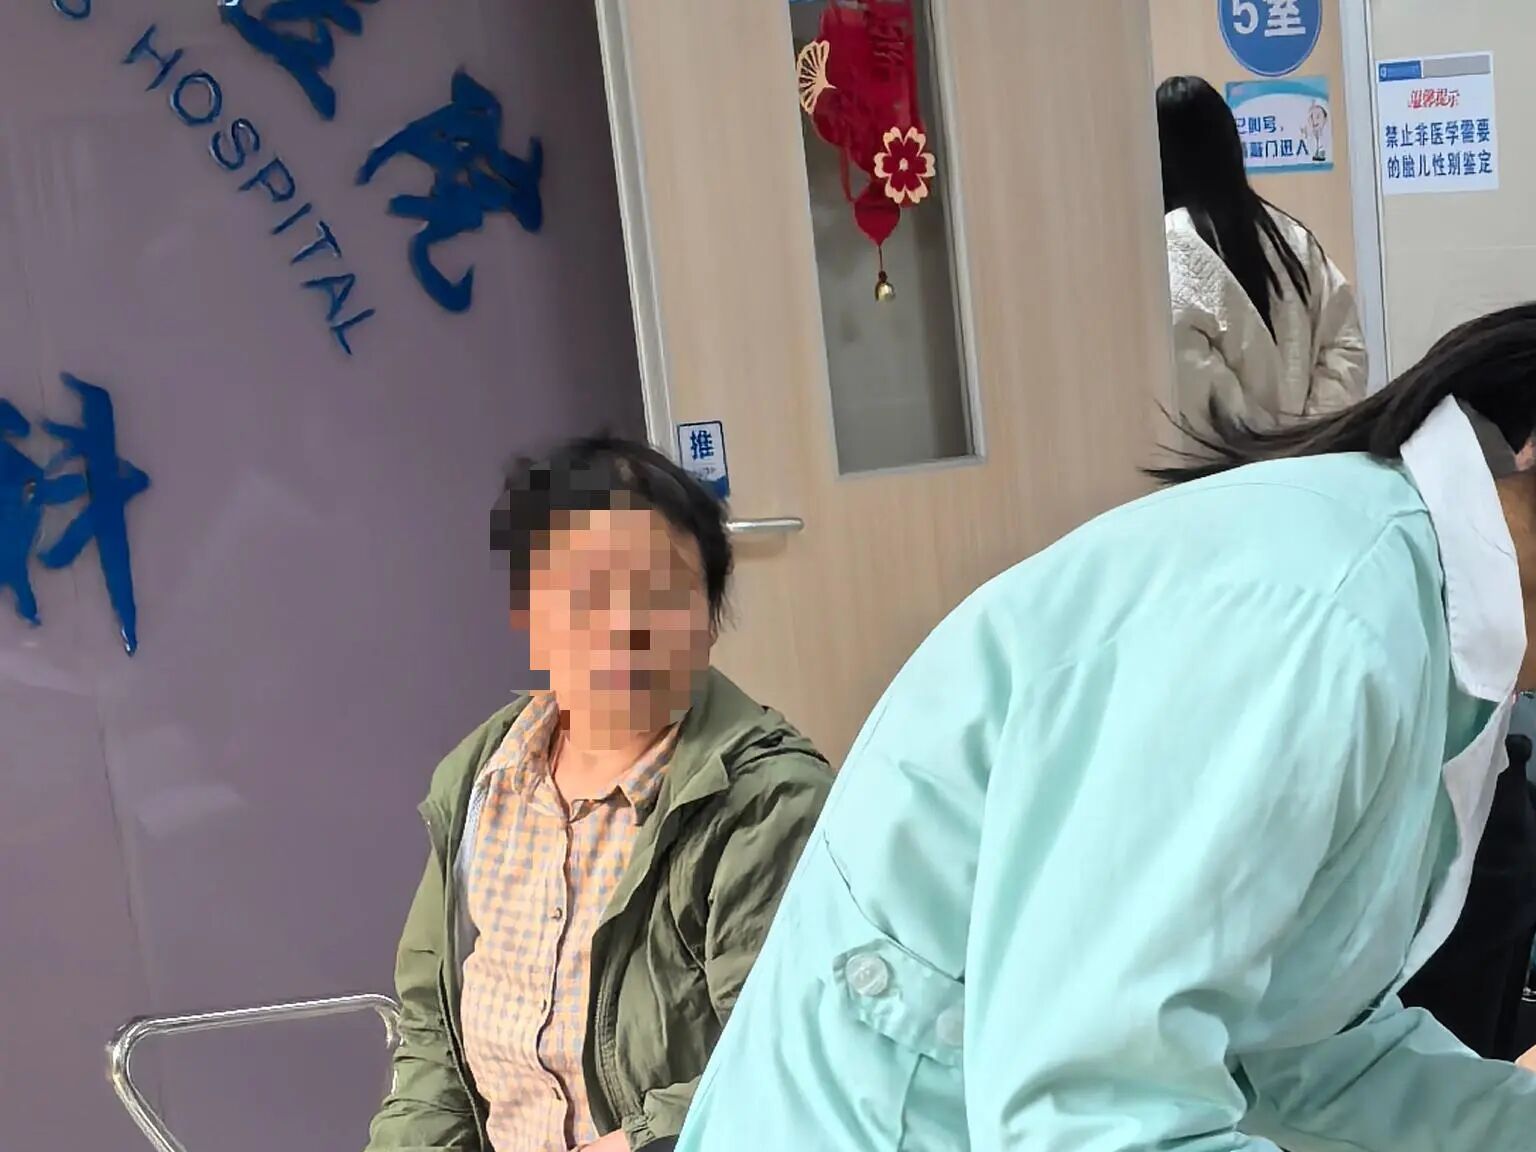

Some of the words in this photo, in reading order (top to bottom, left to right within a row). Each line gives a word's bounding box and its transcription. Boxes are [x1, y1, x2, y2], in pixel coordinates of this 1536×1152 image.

[1232, 0, 1306, 37] 5室
[1385, 118, 1490, 149] 禁止非医学需要
[1387, 149, 1493, 179] 的胎儿性别鉴定
[121, 23, 376, 356] HOSPITAL
[690, 429, 715, 460] 推
